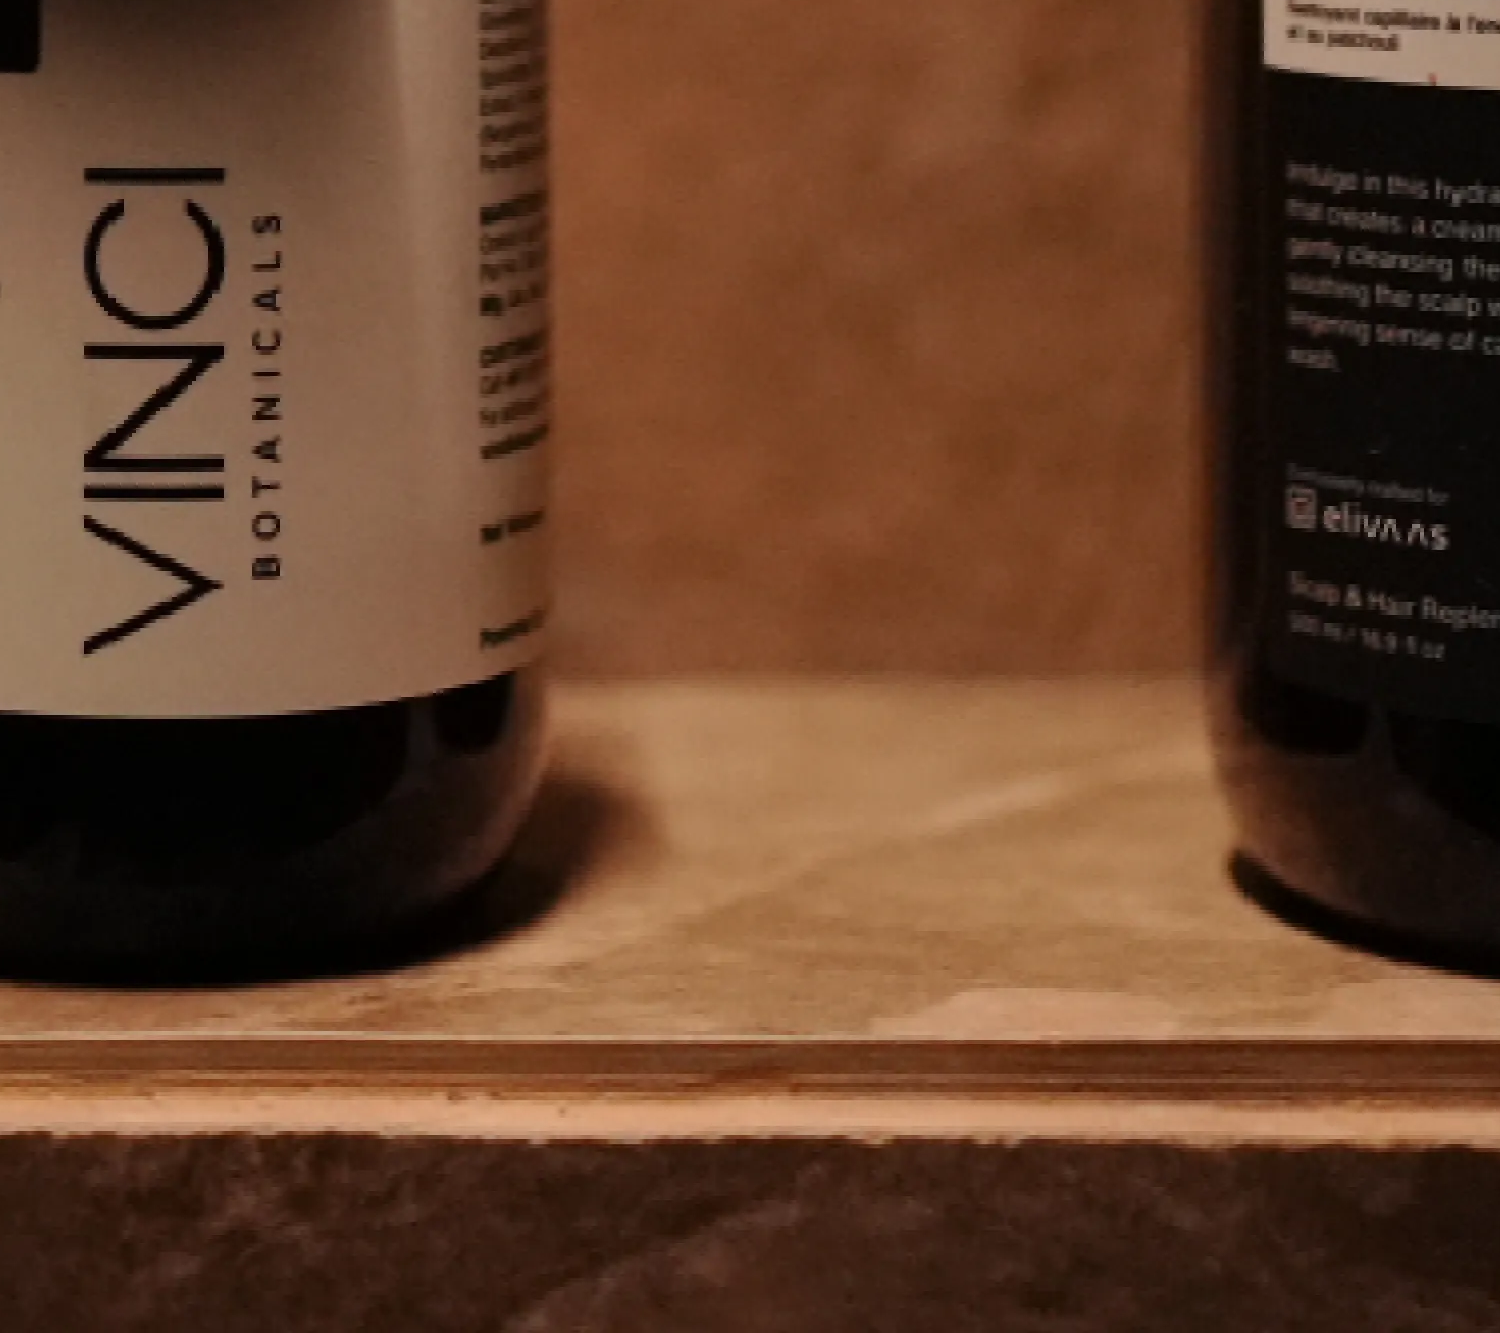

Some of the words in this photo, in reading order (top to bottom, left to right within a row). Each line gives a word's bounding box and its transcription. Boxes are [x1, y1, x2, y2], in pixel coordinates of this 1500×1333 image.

[1346, 244, 1455, 282] cleansing
[1462, 254, 1500, 282] the
[1418, 289, 1481, 321] scalp
[1448, 331, 1477, 353] of
[83, 168, 224, 655] VINCI
[252, 213, 283, 579] BOTANICALS
[1367, 589, 1417, 619] Hair
